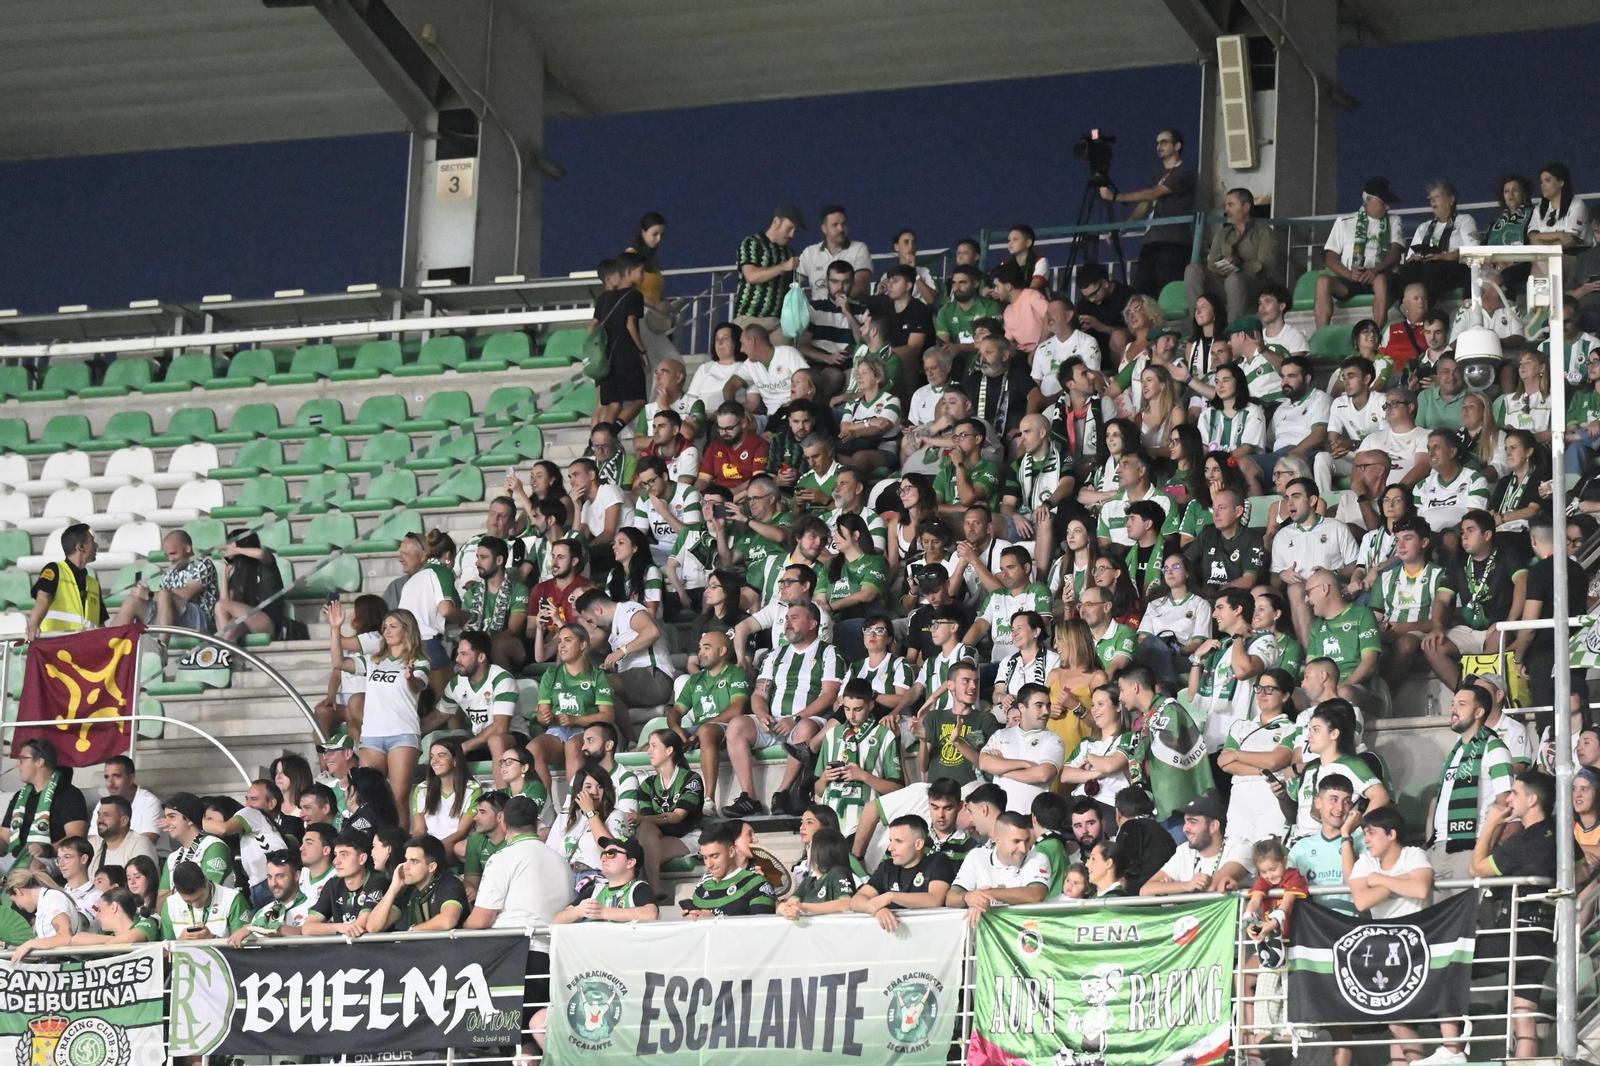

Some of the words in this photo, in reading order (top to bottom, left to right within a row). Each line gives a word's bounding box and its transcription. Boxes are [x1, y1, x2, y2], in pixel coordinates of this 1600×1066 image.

[440, 163, 472, 172] SECTOR
[449, 176, 460, 193] 3
[1449, 821, 1473, 832] RRC
[1075, 920, 1140, 943] PEÑA
[56, 958, 153, 991] FELICES
[1370, 964, 1423, 1007] BUELNA
[6, 992, 38, 1013] DE
[46, 984, 137, 1012] BUELNA
[239, 962, 499, 1035] BUELNA
[1128, 964, 1224, 1031] RACING
[466, 1011, 487, 1031] ON
[490, 1009, 522, 1031] TOUR
[635, 968, 869, 1057] ESCALANTE
[61, 1020, 94, 1051] RACING
[96, 1022, 117, 1047] CLUB
[485, 1035, 498, 1043] José
[568, 1035, 613, 1051] ESCALANTE
[354, 1053, 373, 1063] ON
[377, 1051, 413, 1062] TOUR
[887, 1040, 931, 1054] ESCALANTE
